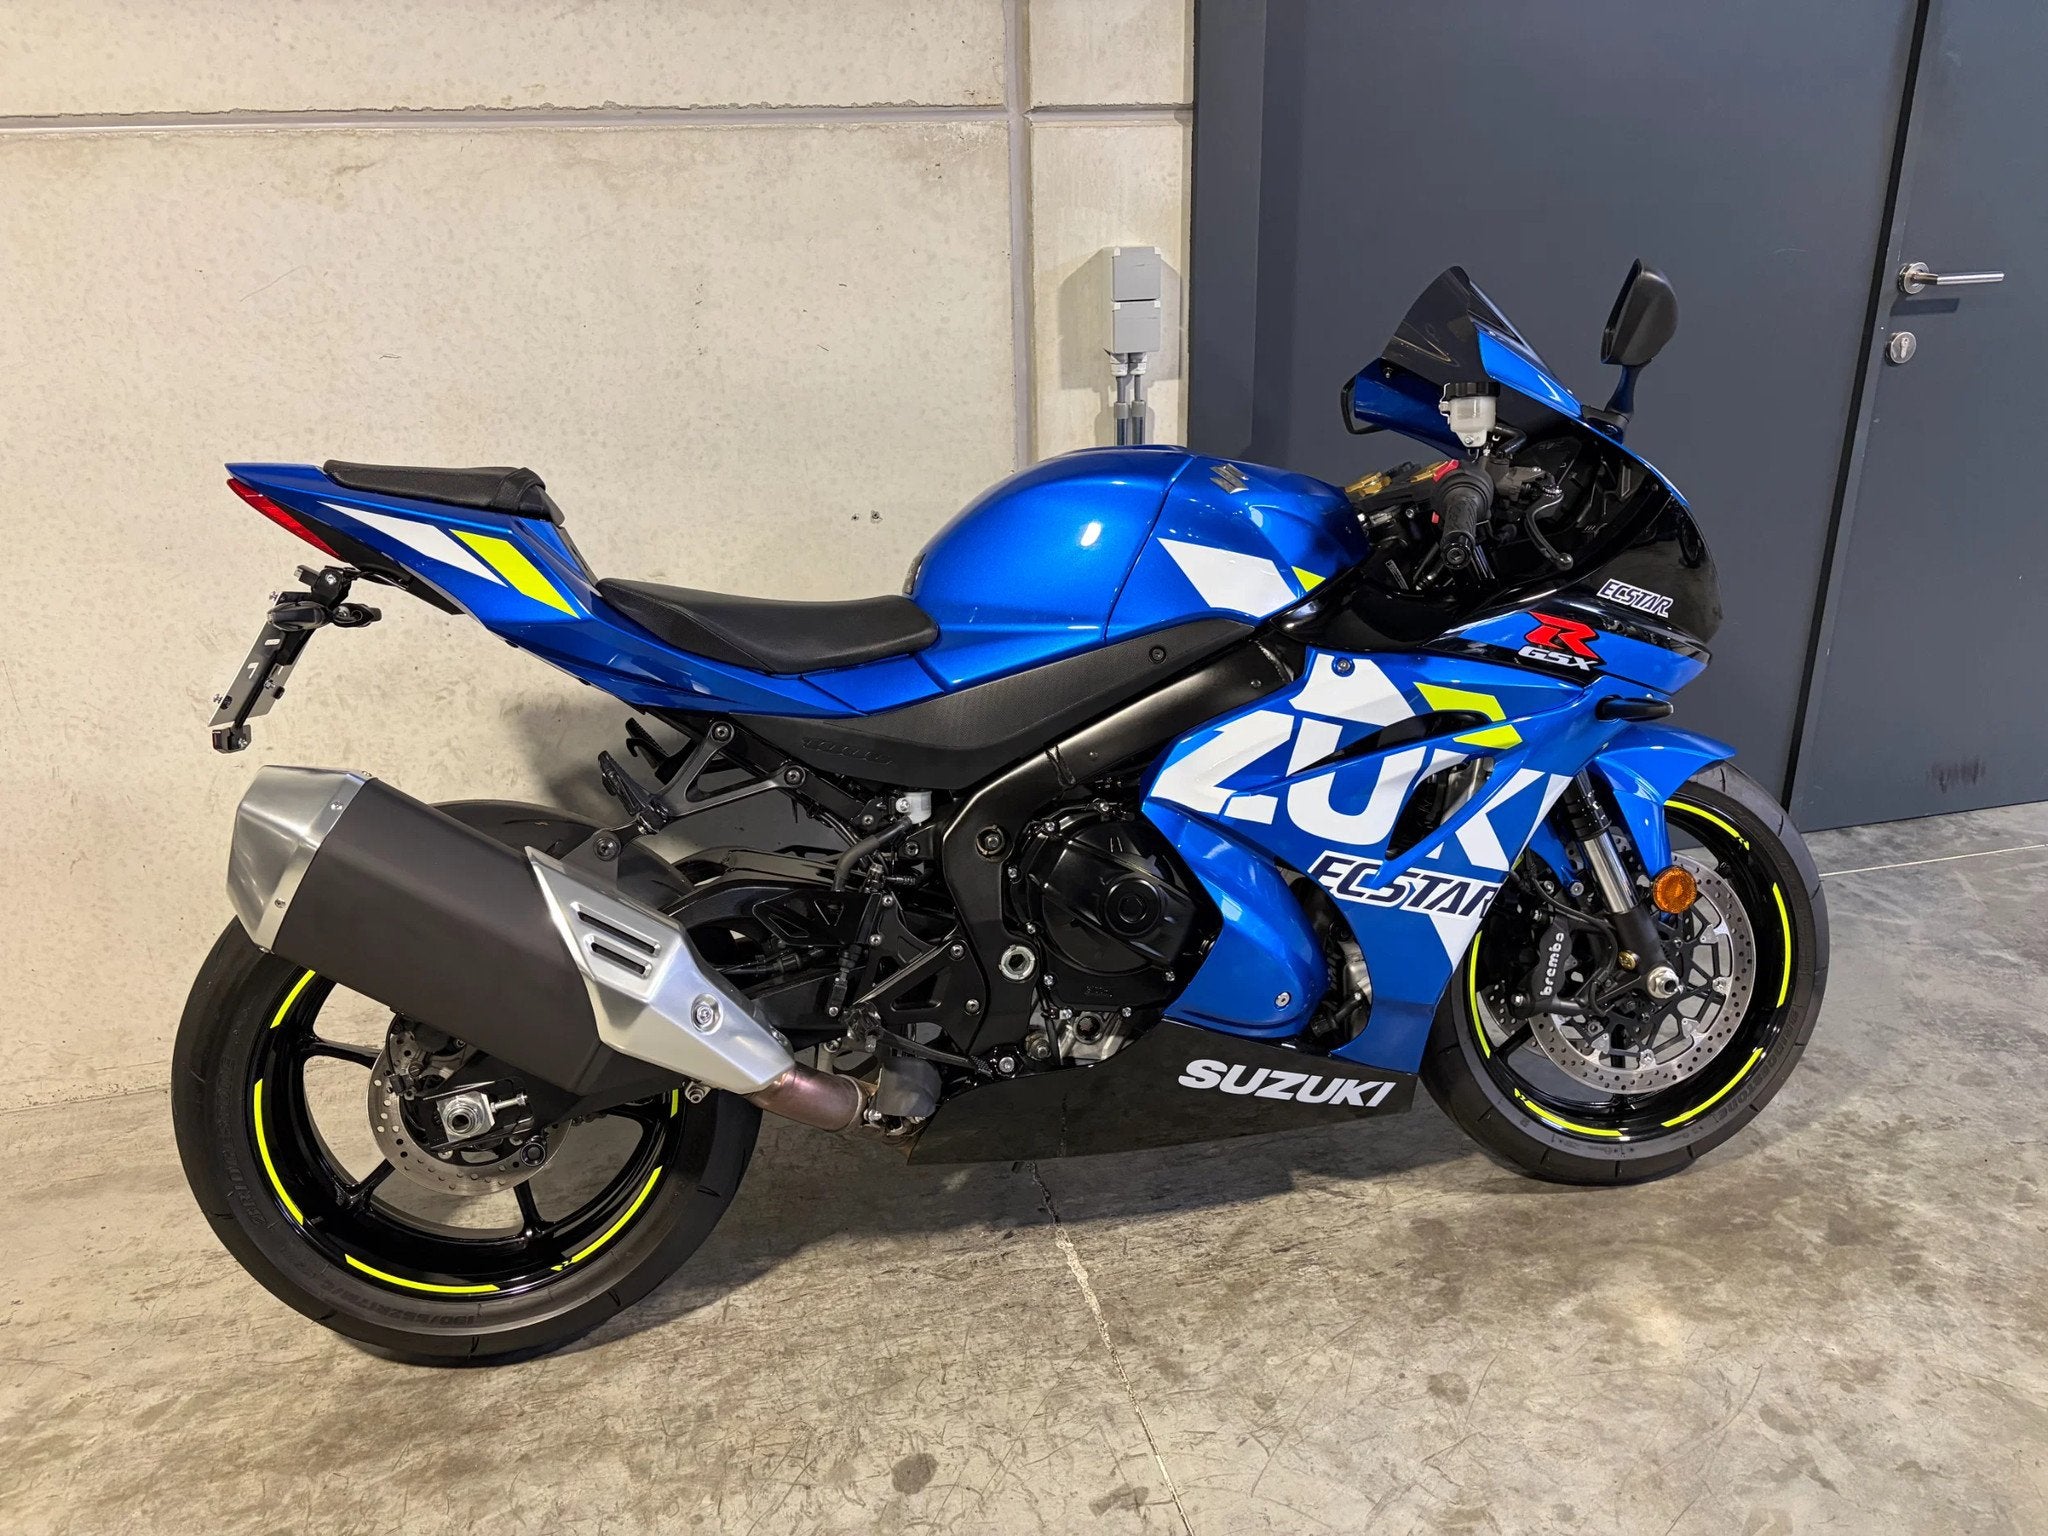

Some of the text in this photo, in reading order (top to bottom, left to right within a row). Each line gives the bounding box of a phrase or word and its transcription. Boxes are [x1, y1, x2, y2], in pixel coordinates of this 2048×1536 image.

[1596, 579, 1674, 618] ECSTAR
[1518, 645, 1599, 671] GSX
[1526, 610, 1600, 660] R
[1539, 932, 1565, 996] brembo
[1178, 1059, 1397, 1108] SUZUKI
